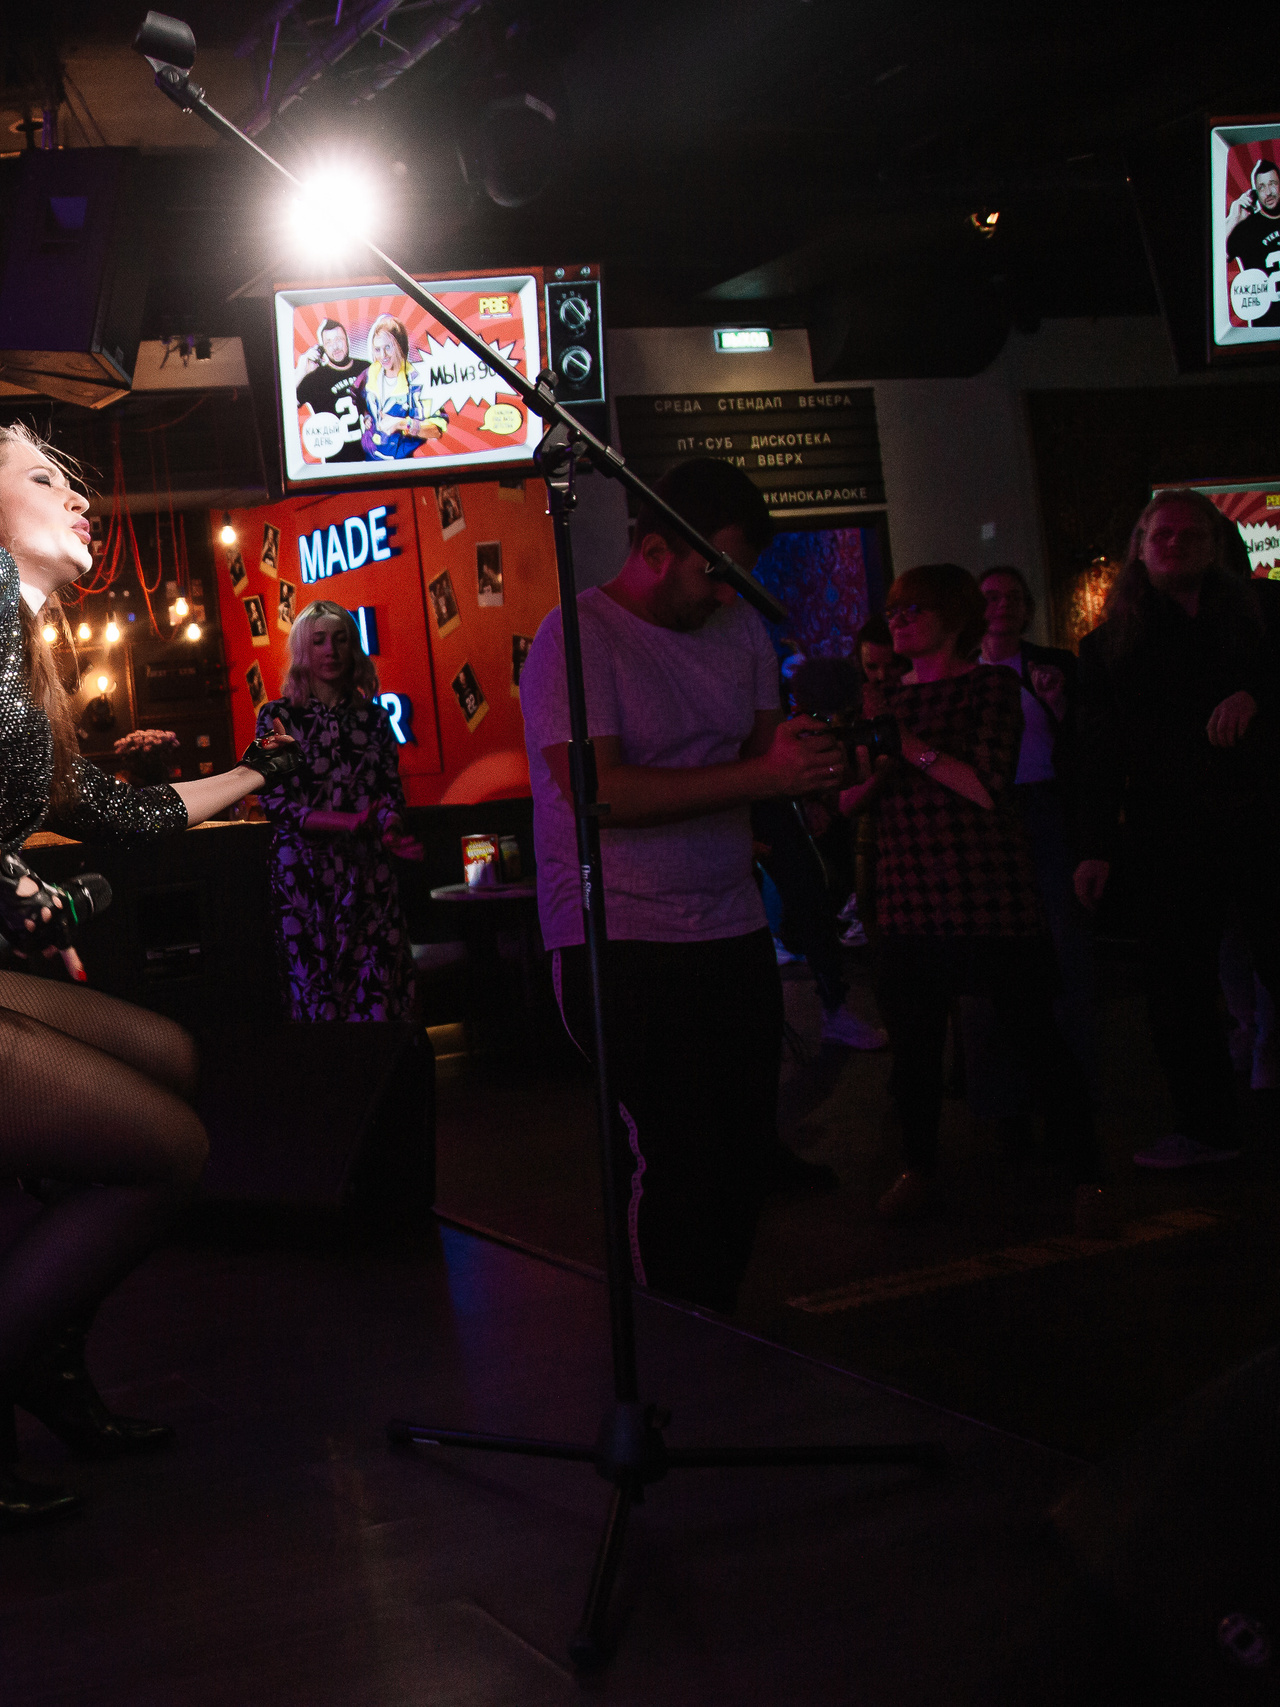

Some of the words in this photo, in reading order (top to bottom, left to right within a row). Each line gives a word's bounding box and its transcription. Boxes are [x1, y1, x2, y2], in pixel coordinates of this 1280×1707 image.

[1234, 280, 1268, 295] КАЖДЫЙ
[478, 295, 510, 314] РВБ
[1241, 297, 1261, 308] ДЕНЬ
[654, 400, 702, 413] СРЕДА
[718, 396, 783, 411] СТЕНДАП
[798, 394, 852, 408] ВЕЧЕРА
[305, 422, 340, 436] КАЖДЫЙ
[314, 437, 334, 448] ДЕНЬ
[677, 436, 733, 451] ПТ-СУБ
[750, 432, 832, 449] ДИСКОТЕКА
[757, 453, 803, 467] ВВЕРХ
[298, 505, 392, 584] MADE
